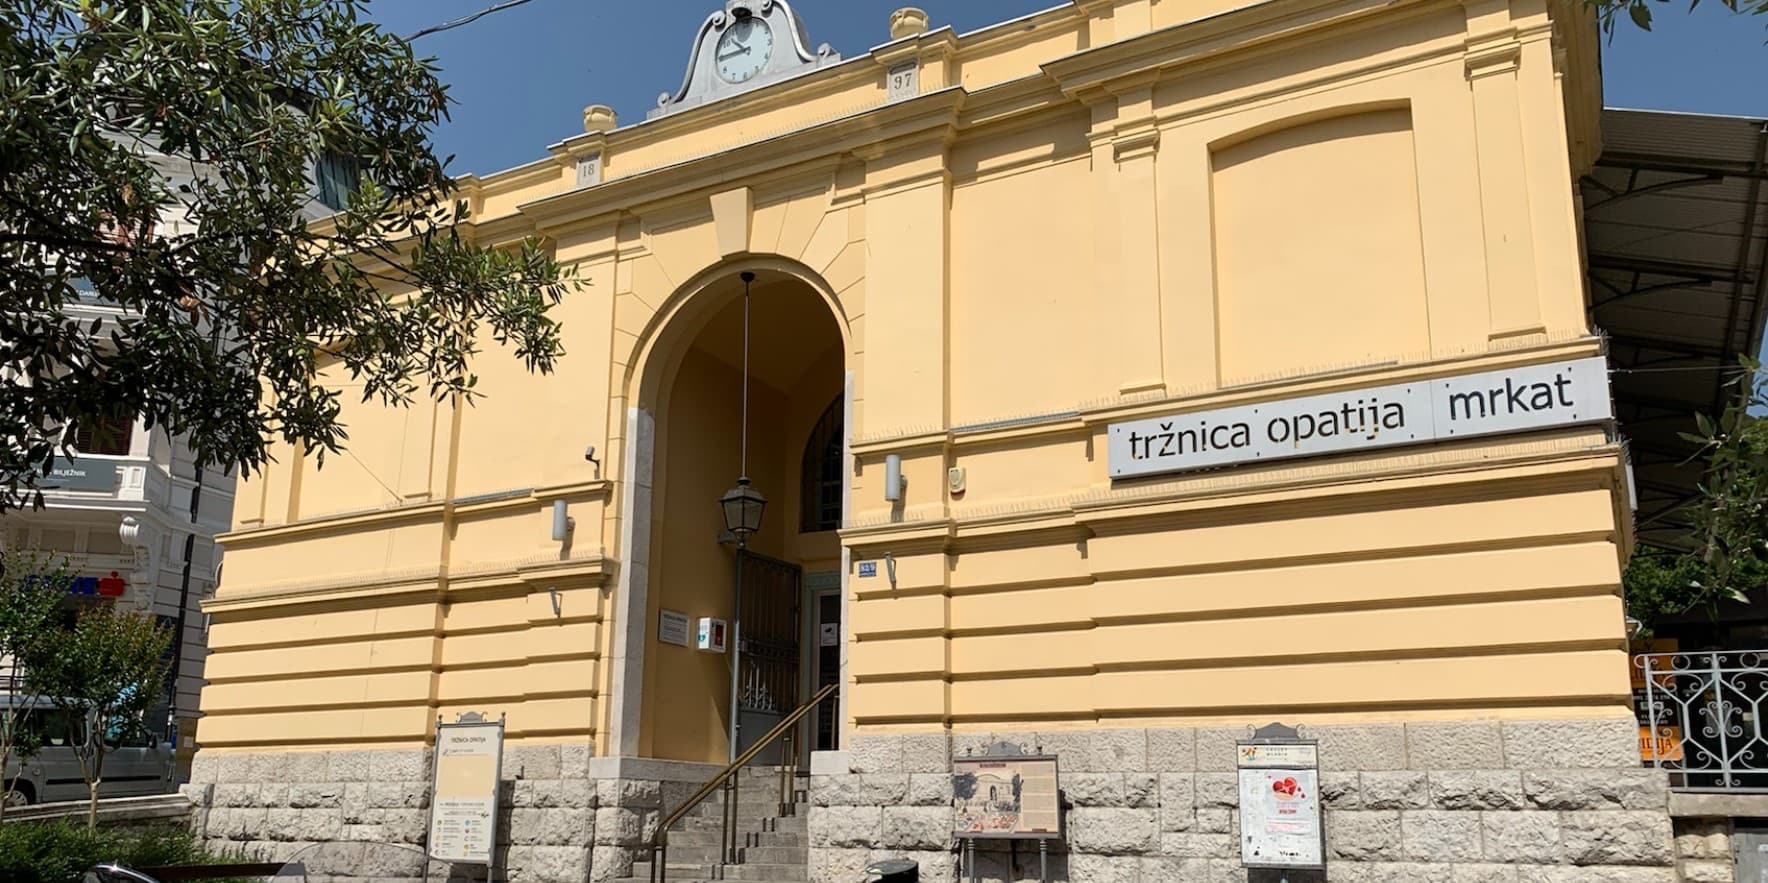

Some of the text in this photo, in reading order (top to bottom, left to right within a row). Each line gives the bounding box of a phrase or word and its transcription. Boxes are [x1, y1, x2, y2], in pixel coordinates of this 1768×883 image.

[894, 72, 912, 89] 97
[583, 163, 595, 177] 18
[1129, 373, 1574, 460] tržnica opatija mrkat
